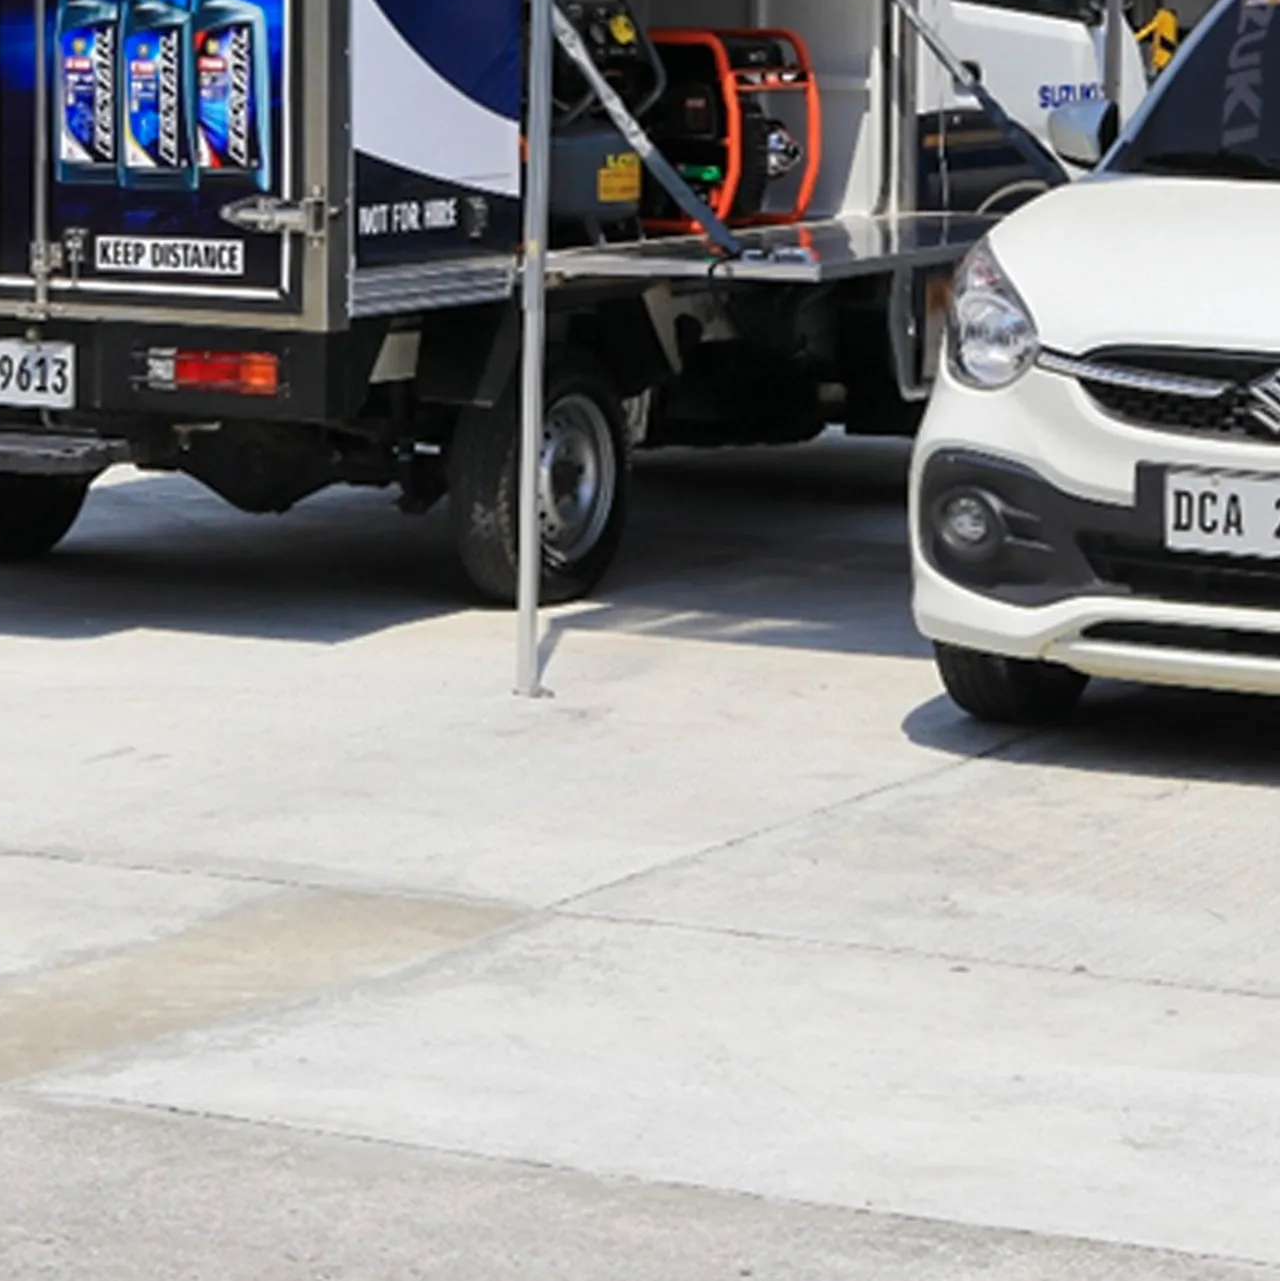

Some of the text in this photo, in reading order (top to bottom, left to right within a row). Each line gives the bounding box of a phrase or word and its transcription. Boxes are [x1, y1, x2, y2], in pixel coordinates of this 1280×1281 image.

[1038, 82, 1103, 108] SUZUK
[359, 202, 388, 235] NOT
[392, 201, 420, 232] FOR
[99, 240, 238, 271] KEEP DISTANCE
[1173, 490, 1244, 536] DCA
